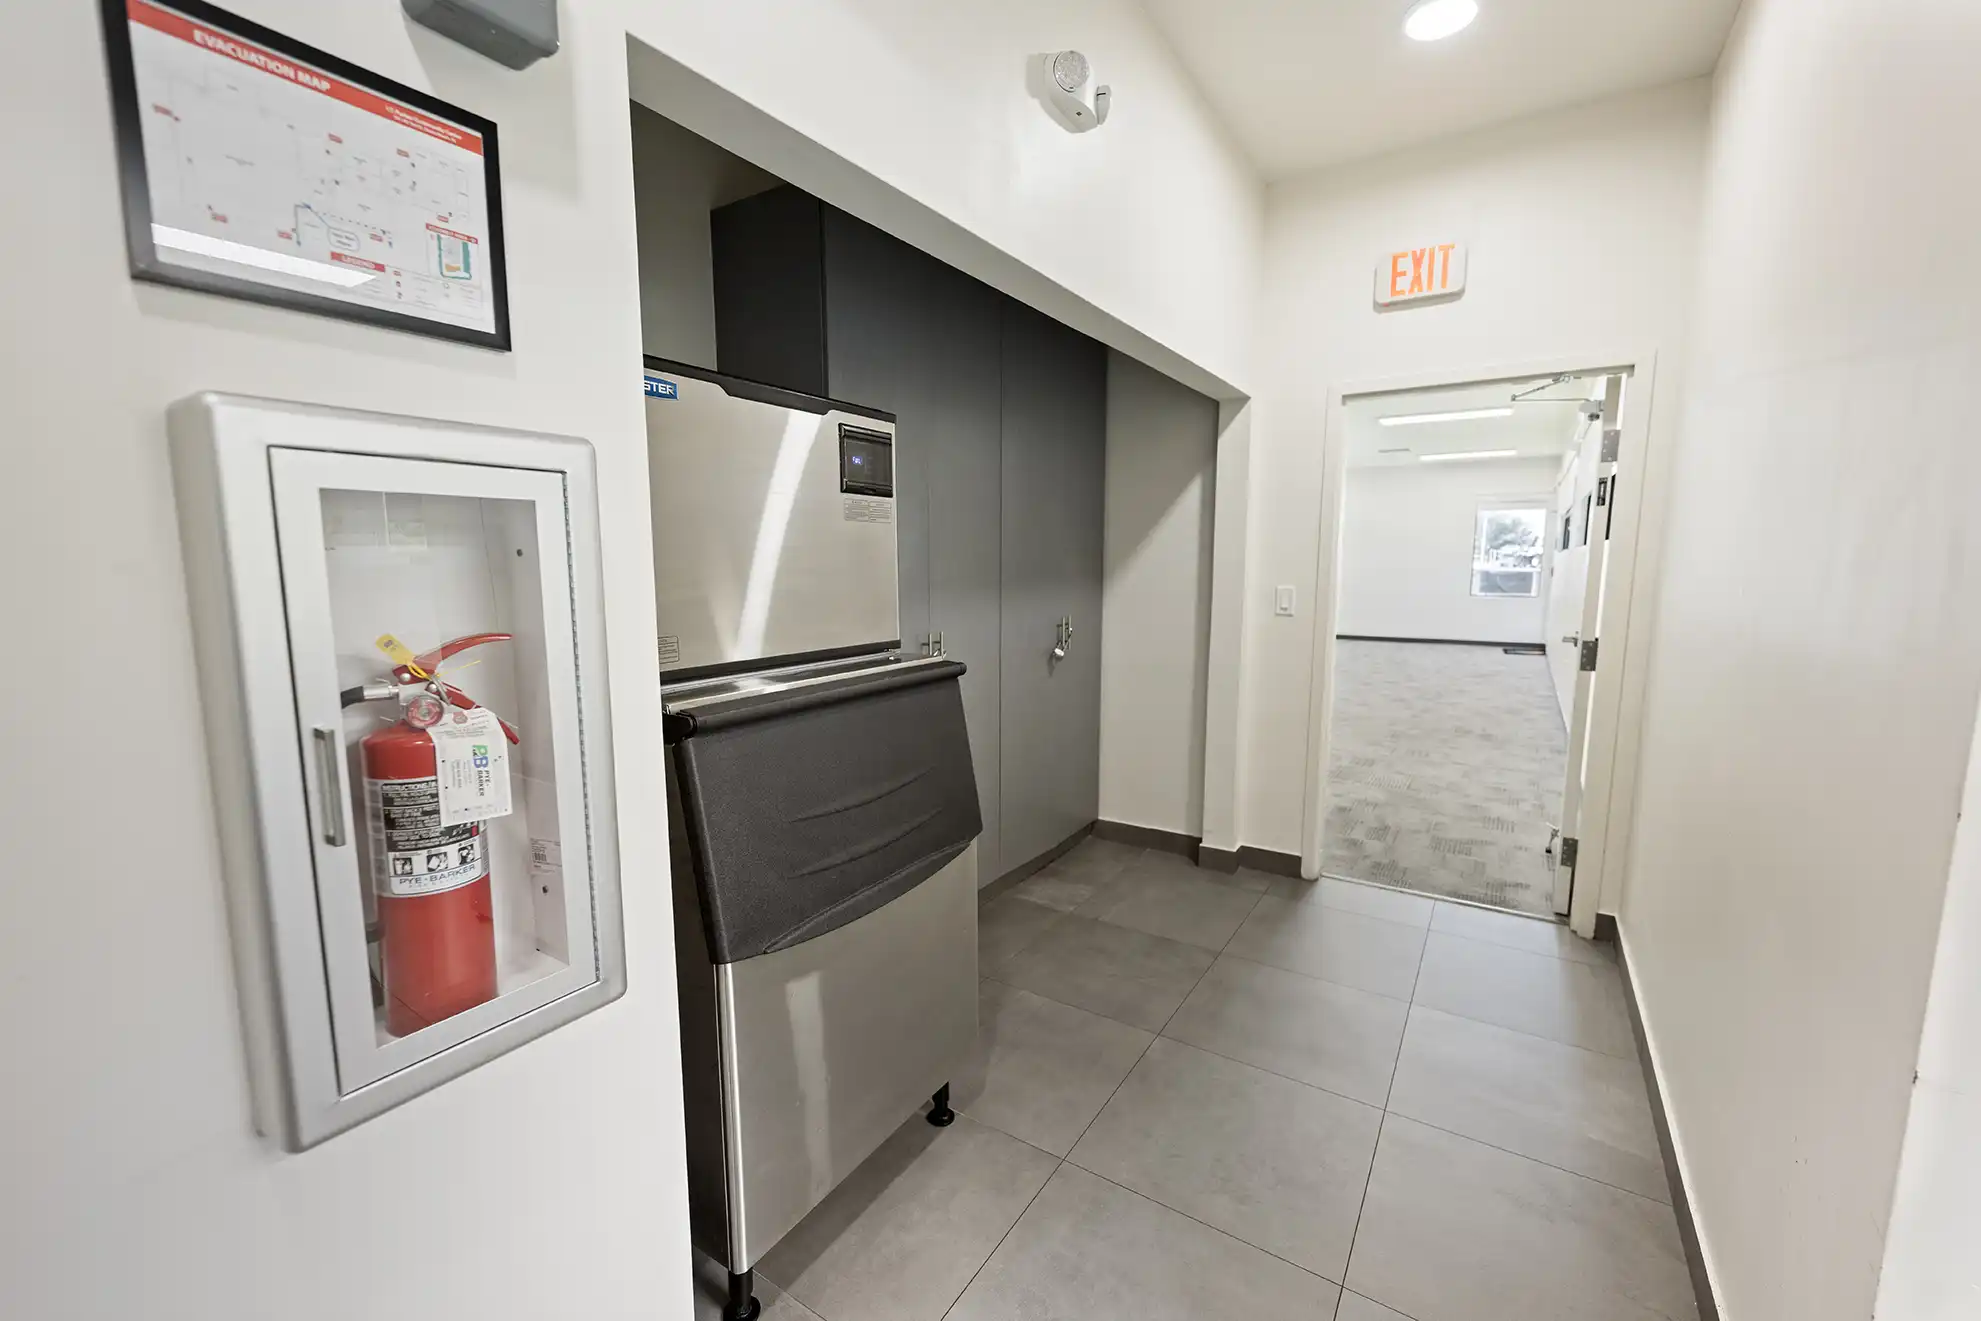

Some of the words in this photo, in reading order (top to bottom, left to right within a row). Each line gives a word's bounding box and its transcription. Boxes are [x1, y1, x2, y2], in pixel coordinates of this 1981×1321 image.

[193, 29, 295, 80] EVACUATION
[296, 70, 331, 91] MAP
[1390, 243, 1455, 297] EXIT
